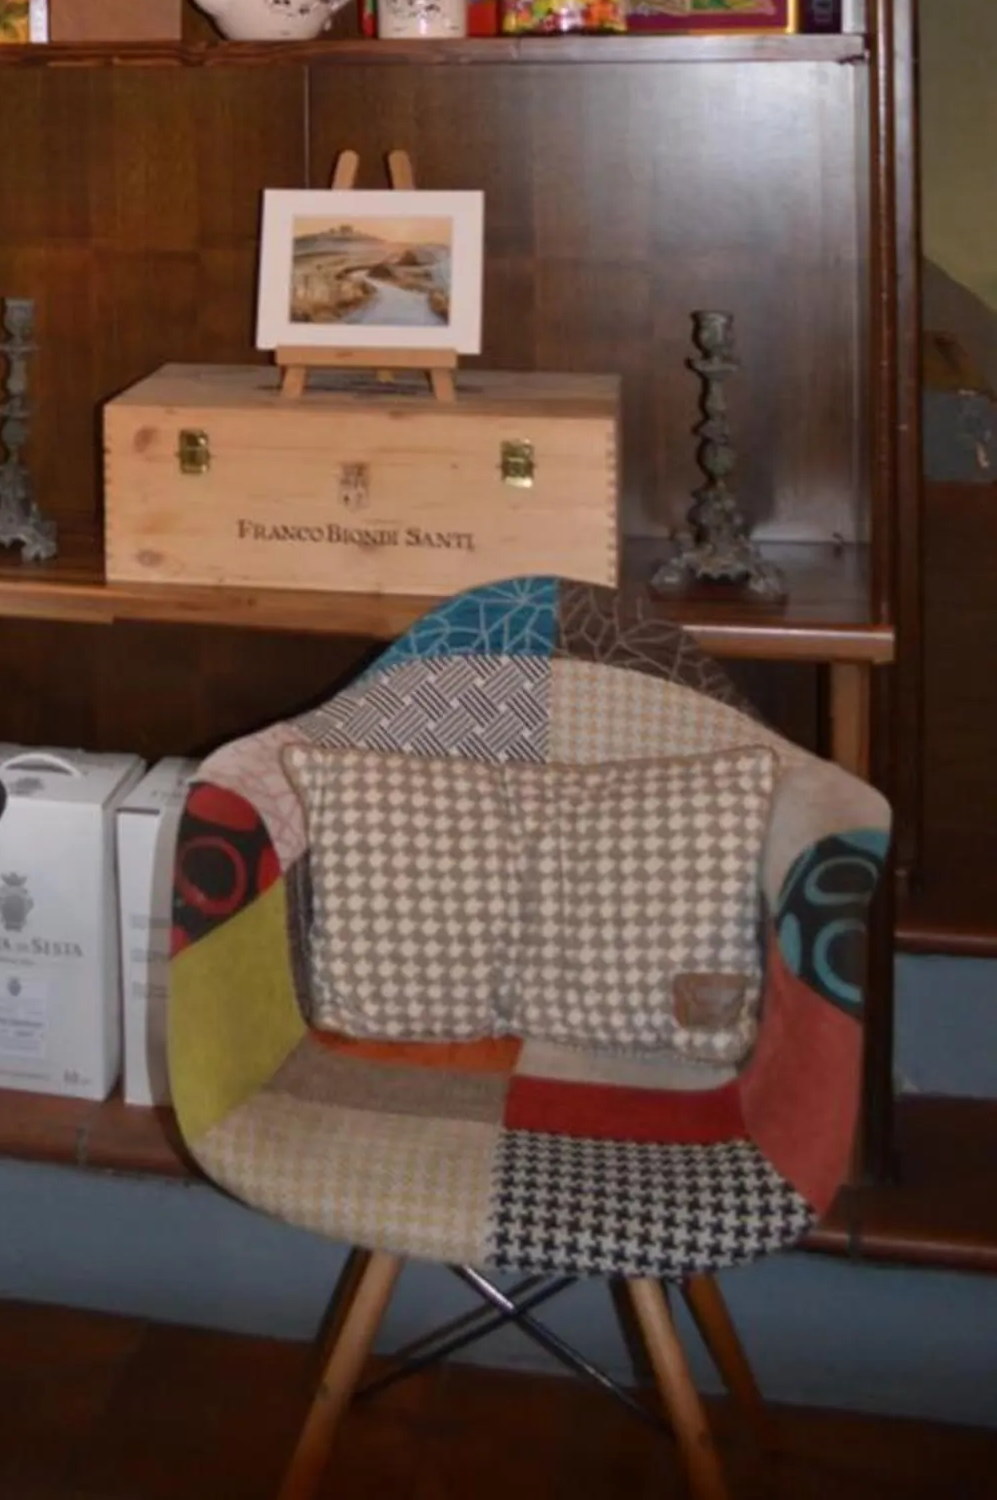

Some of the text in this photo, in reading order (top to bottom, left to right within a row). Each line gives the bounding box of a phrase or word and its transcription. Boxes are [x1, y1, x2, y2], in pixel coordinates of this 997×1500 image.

[236, 518, 476, 551] FRANCO BIONDI SANTI
[31, 936, 84, 957] SESTA
